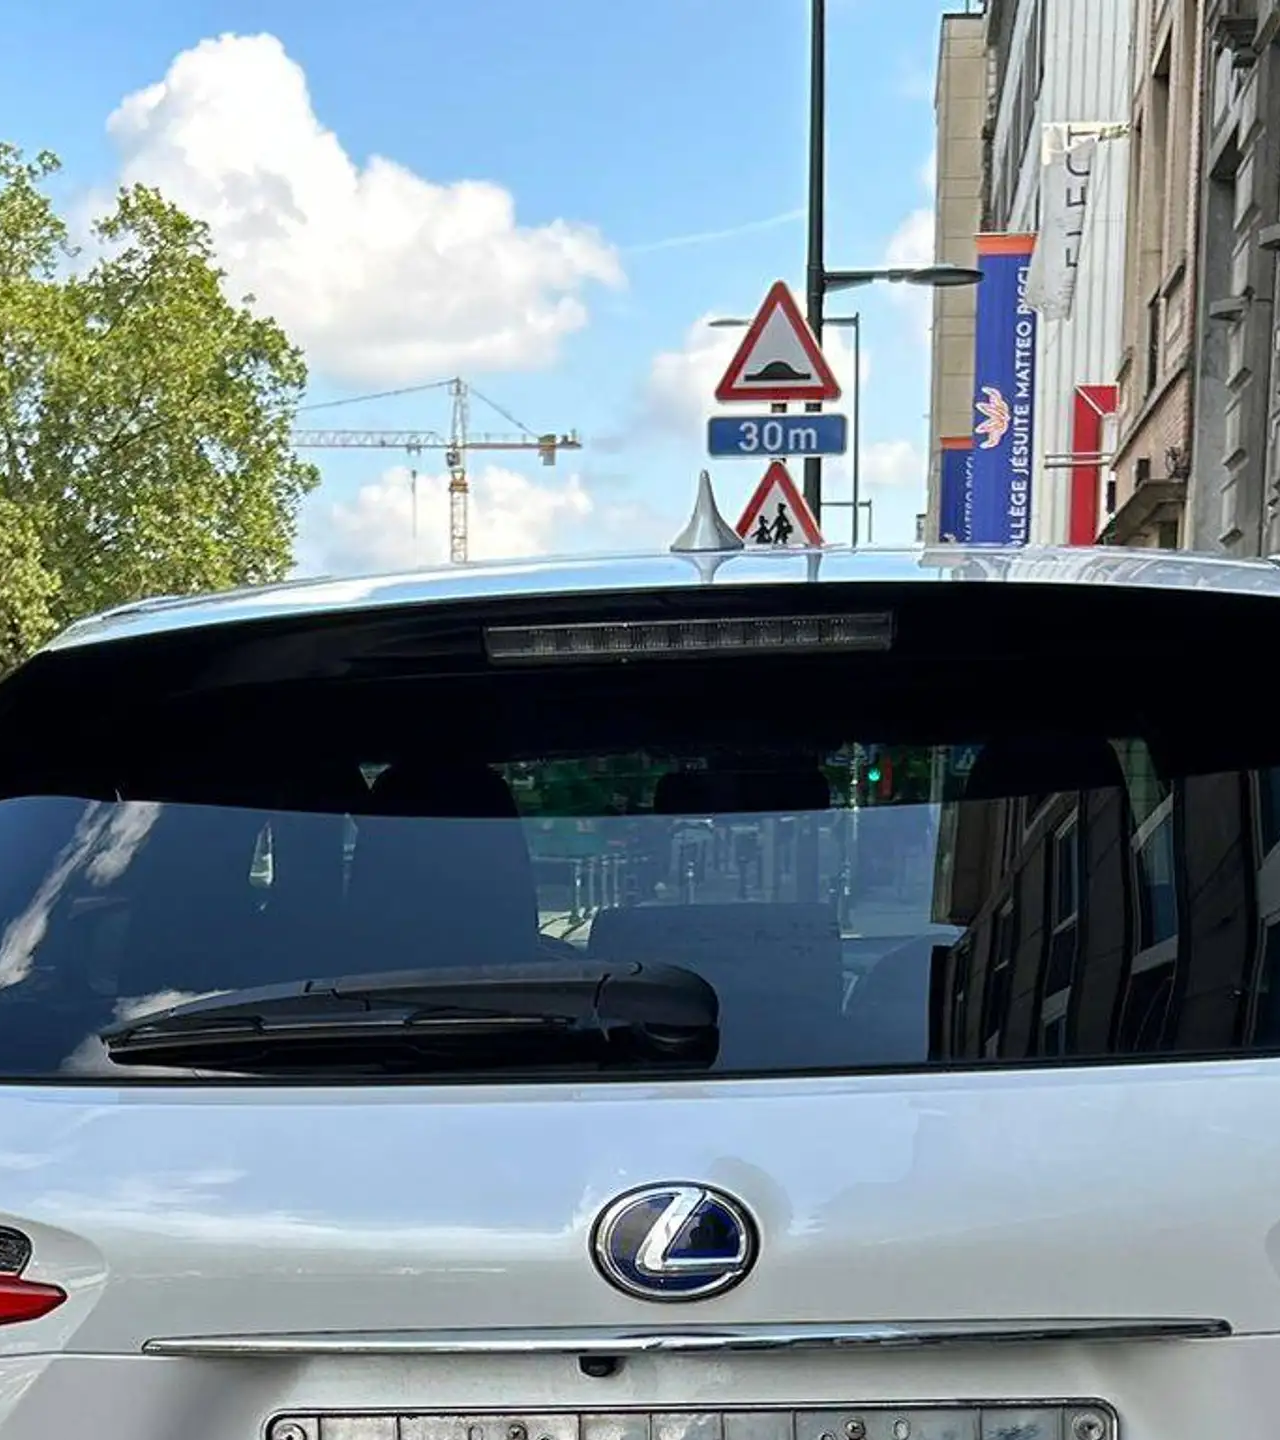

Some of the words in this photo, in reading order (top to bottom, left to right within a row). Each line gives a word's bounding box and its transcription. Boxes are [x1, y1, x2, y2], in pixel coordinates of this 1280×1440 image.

[1015, 321, 1032, 398] MATTEO
[1009, 405, 1029, 475] JÉSUITE
[1007, 481, 1027, 545] LLÈGE
